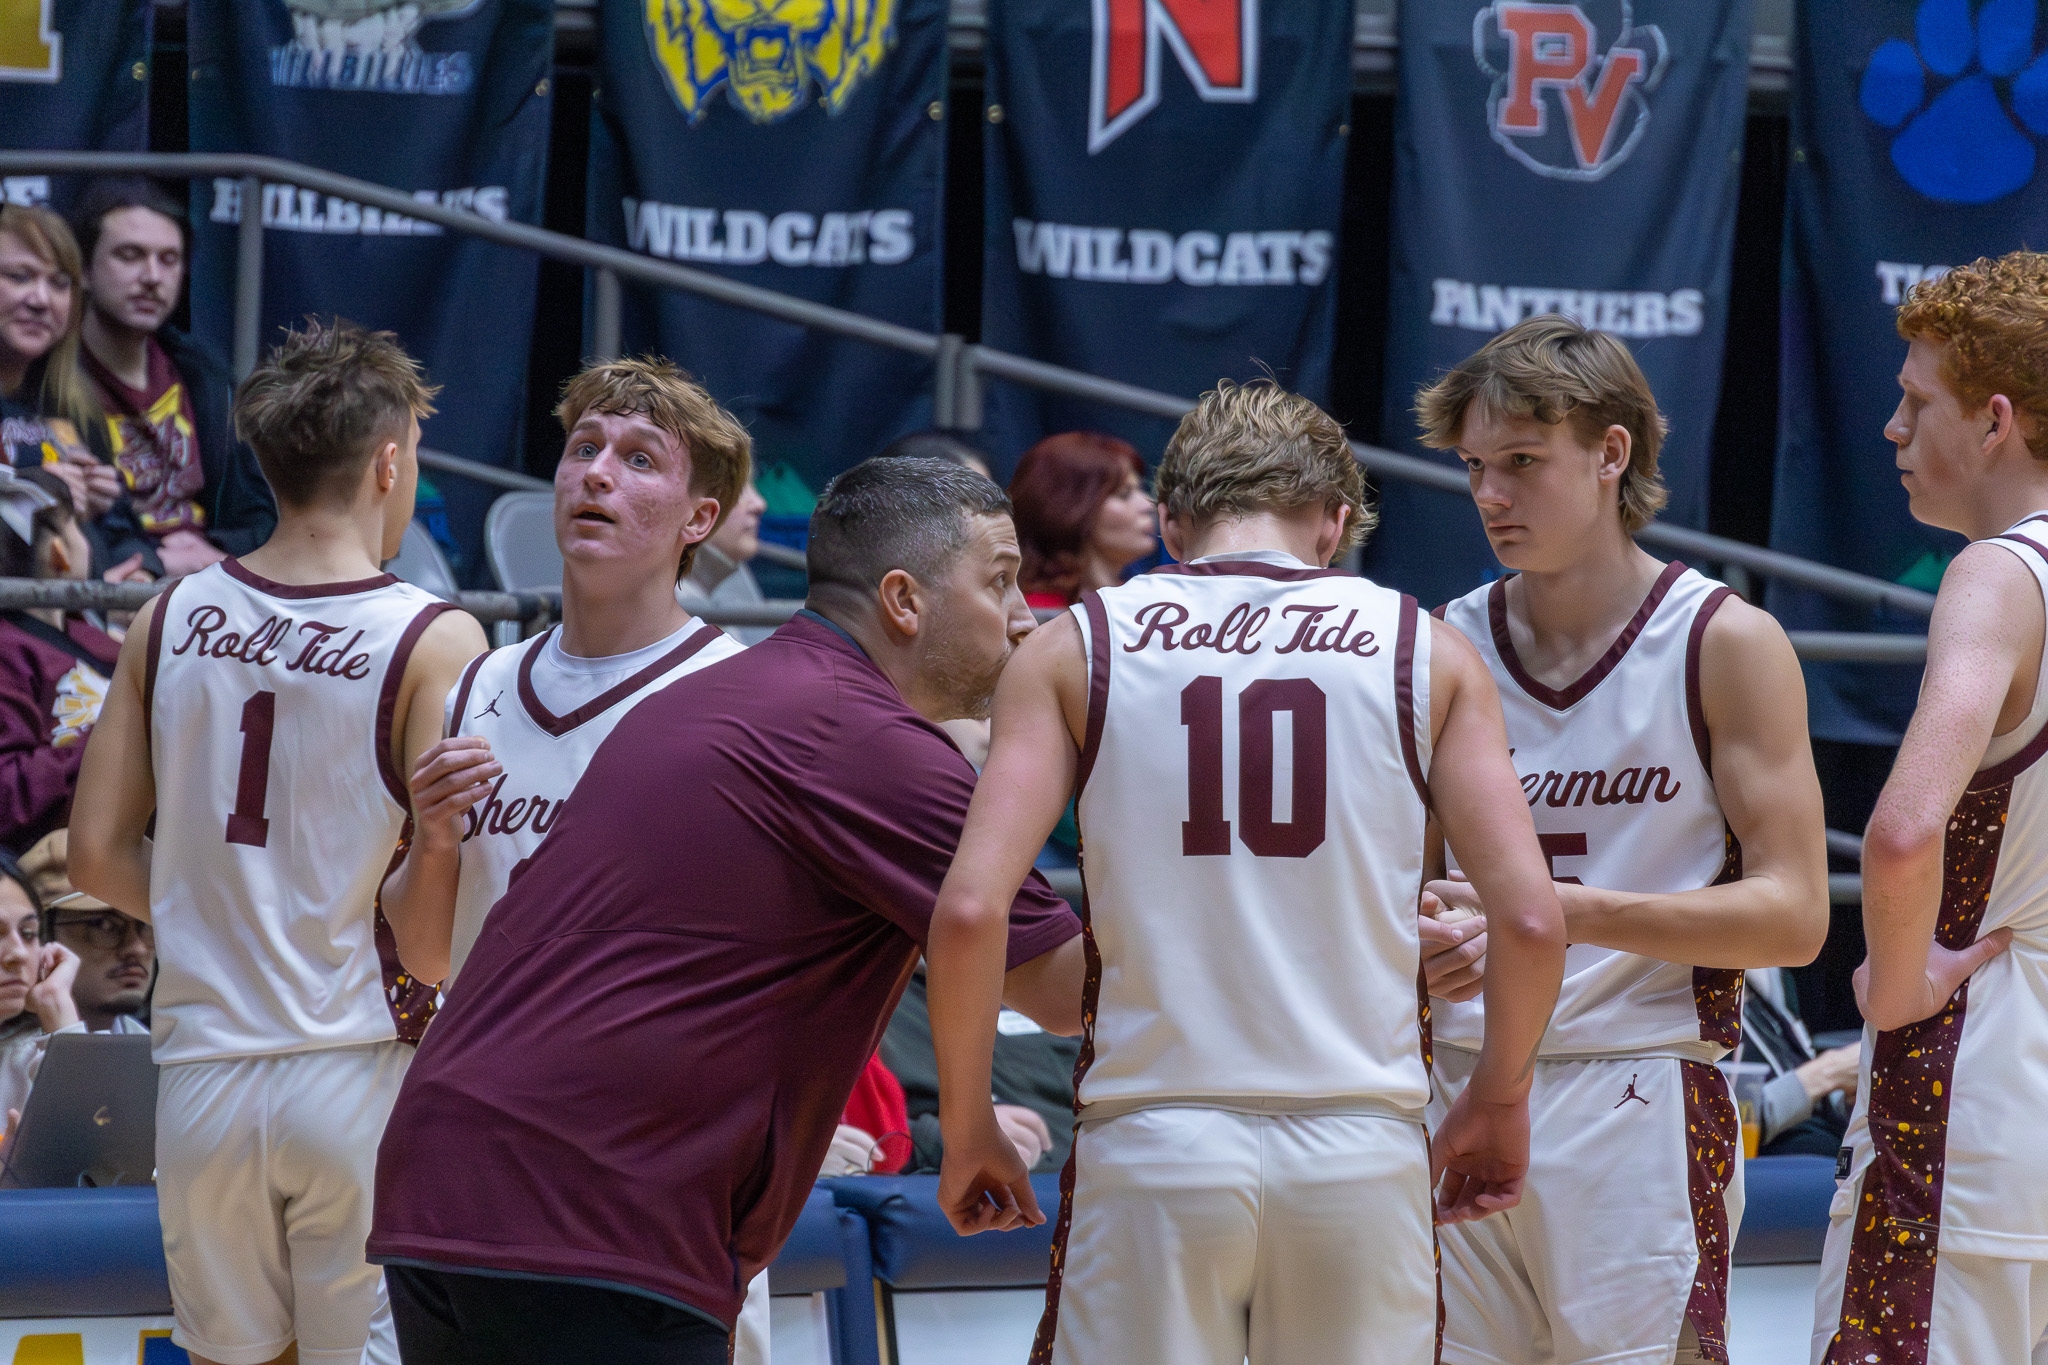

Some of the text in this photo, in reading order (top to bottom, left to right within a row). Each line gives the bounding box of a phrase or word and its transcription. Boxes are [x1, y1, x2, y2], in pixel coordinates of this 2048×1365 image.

[1496, 1, 1647, 170] PV
[621, 196, 916, 267] WILDCATS
[1012, 217, 1335, 287] WILDCATS
[1429, 276, 1704, 337] PANTHERS
[172, 604, 370, 680] Roll Tide
[1122, 601, 1380, 657] Roll Tide
[224, 689, 277, 849] 1
[1179, 674, 1328, 860] 10
